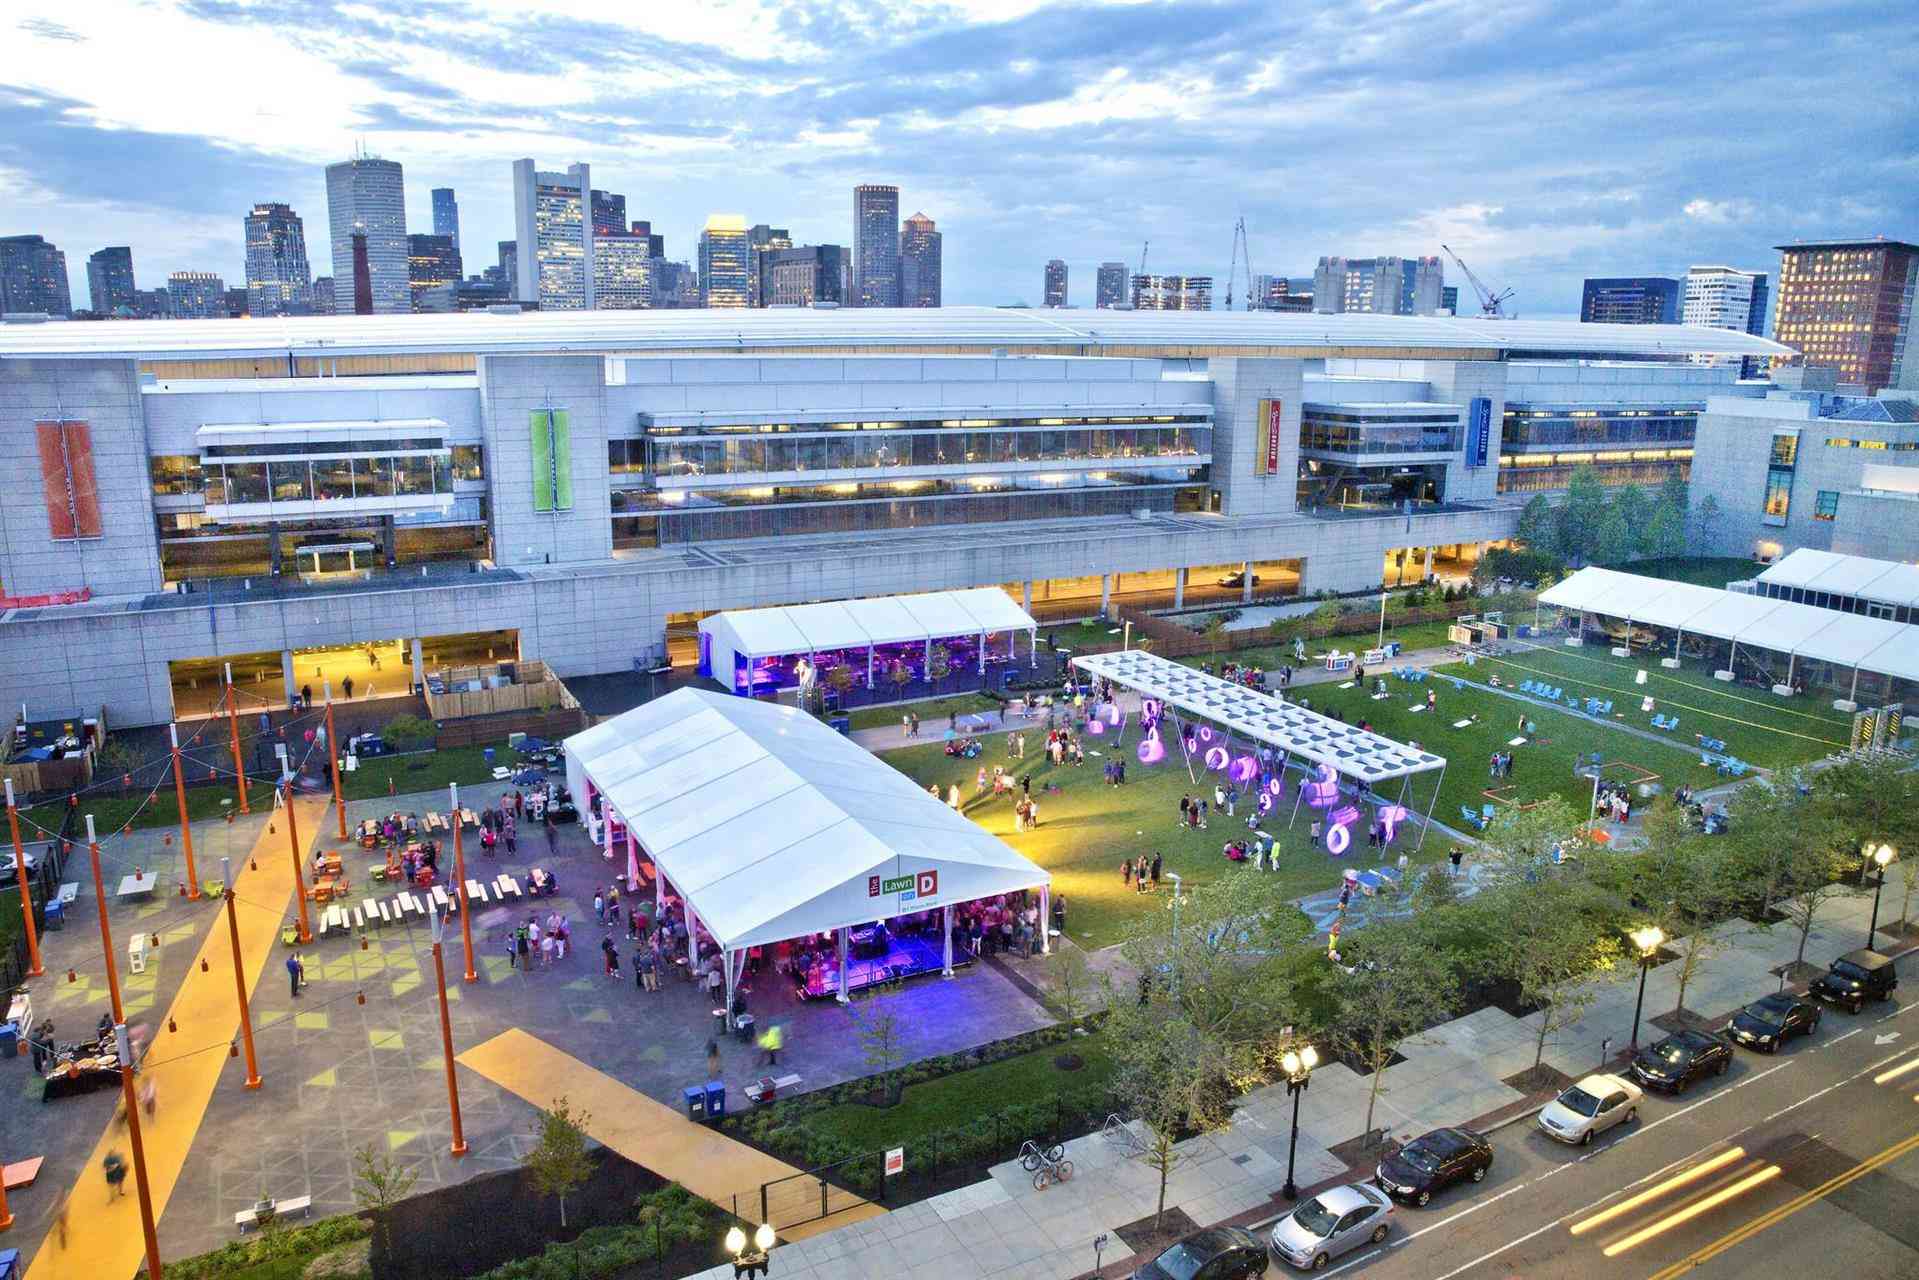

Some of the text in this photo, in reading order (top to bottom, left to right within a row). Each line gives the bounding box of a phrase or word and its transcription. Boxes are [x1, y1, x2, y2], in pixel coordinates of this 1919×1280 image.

[870, 878, 878, 895] the
[885, 879, 913, 891] Lawn
[920, 876, 934, 893] D
